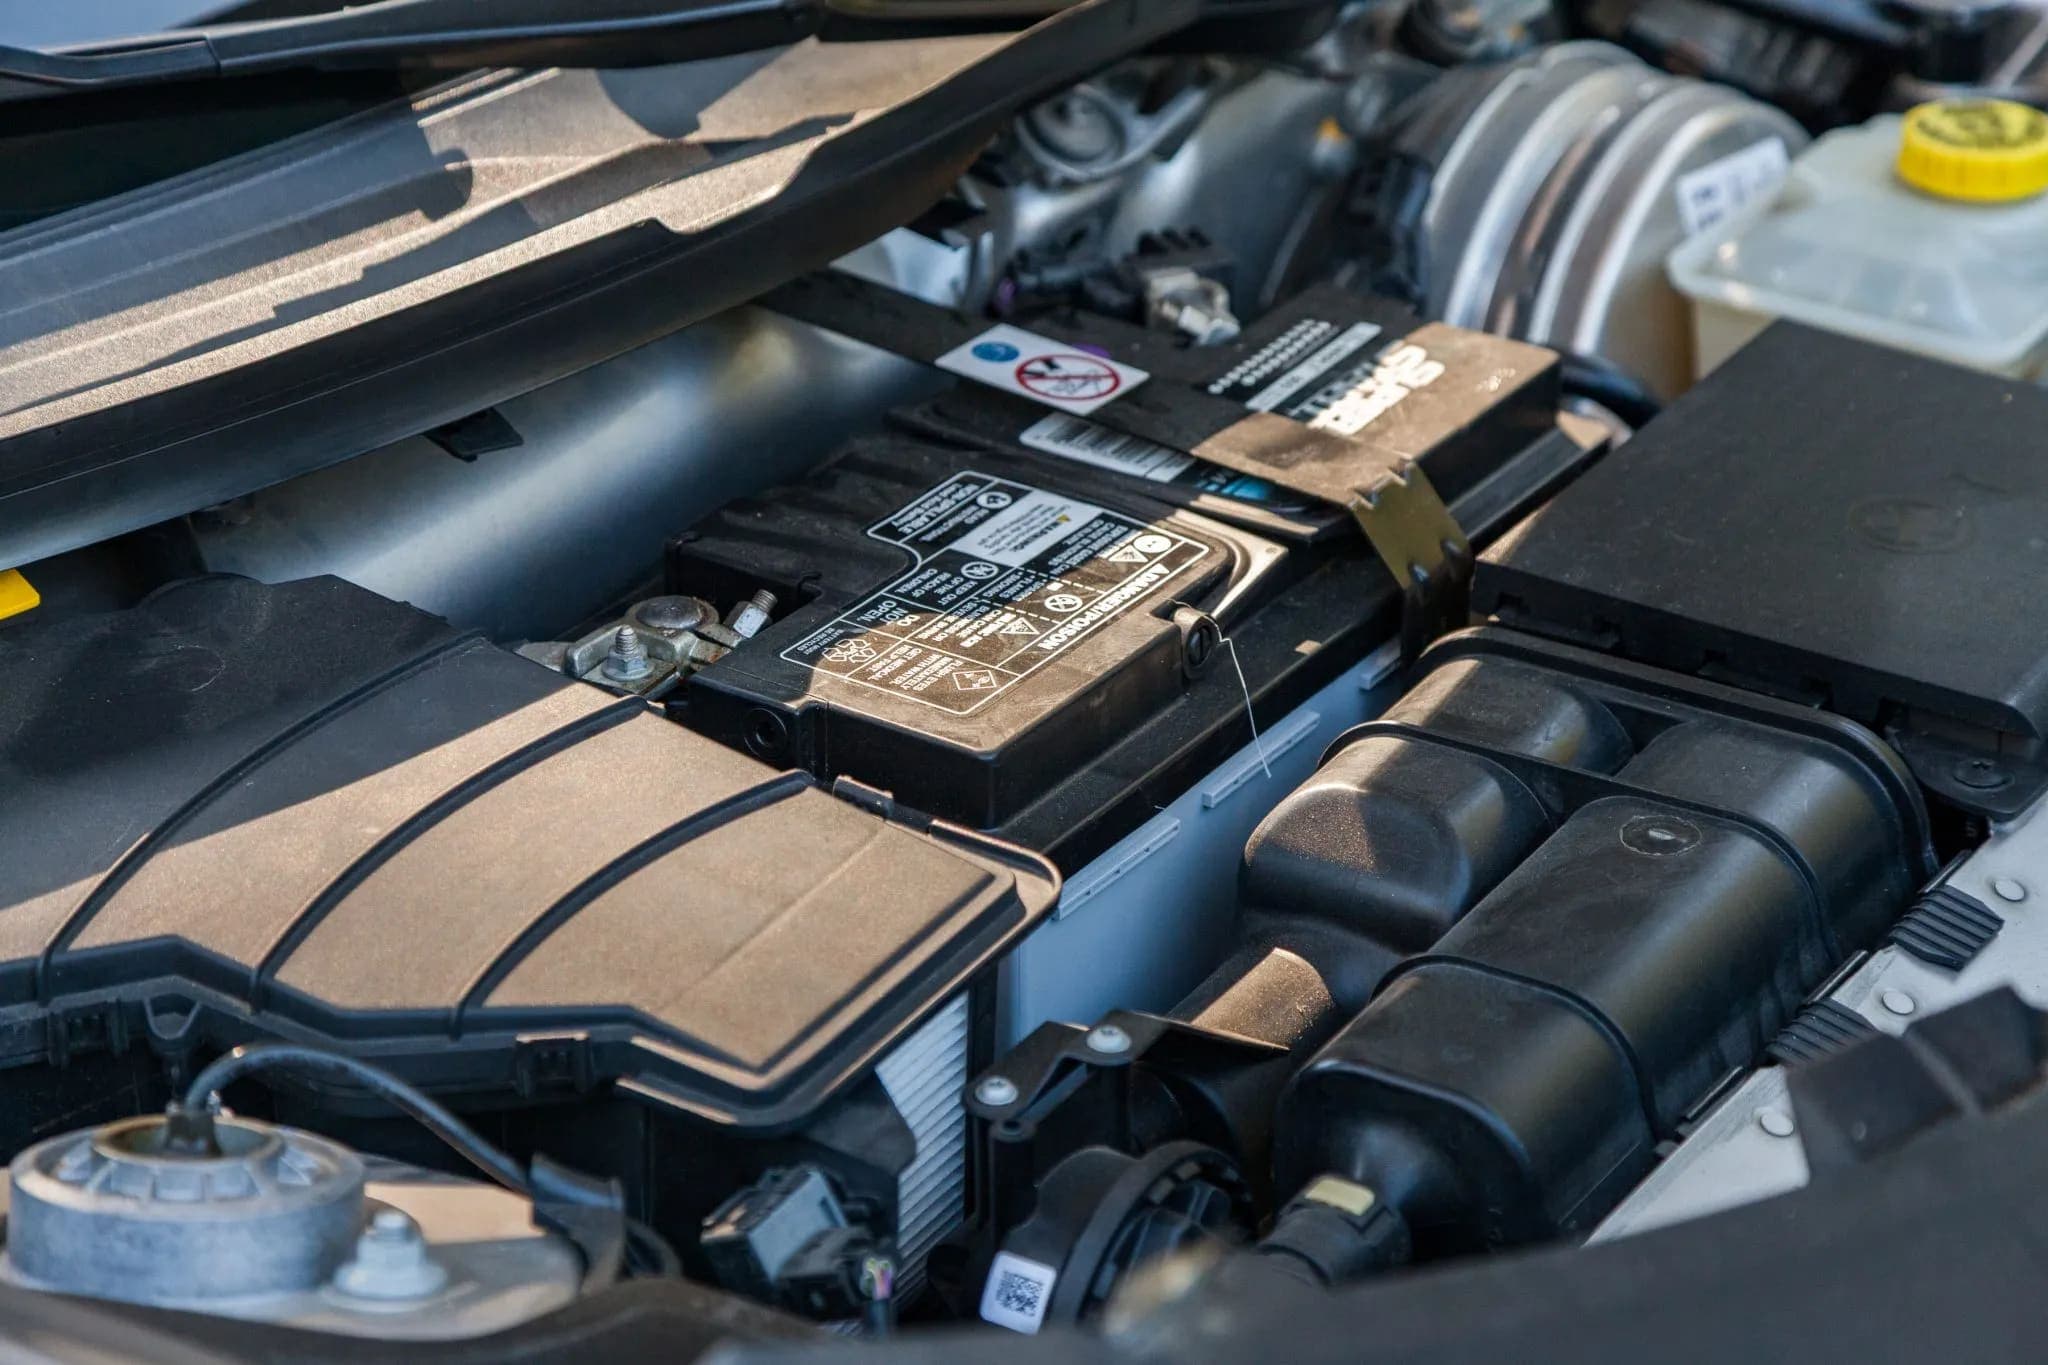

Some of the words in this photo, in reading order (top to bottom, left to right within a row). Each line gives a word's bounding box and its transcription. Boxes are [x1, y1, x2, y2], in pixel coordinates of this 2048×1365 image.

[1049, 563, 1072, 575] CAN
[893, 568, 937, 593] CHILDREN.
[920, 571, 951, 589] REACH
[948, 575, 964, 584] OF
[952, 580, 978, 594] KEEP
[981, 573, 1021, 597] SMOKING
[997, 577, 1033, 598] FLAMES
[907, 588, 925, 597] OF
[932, 582, 954, 594] THE
[935, 593, 957, 605] OUT
[855, 599, 897, 623] OPEN.
[876, 607, 908, 625] NOT
[942, 601, 978, 622] SEVERE
[980, 608, 1003, 621] CAN
[1036, 570, 1160, 649] DANGER/POISON
[894, 613, 920, 627] DO
[942, 605, 990, 633] BLINDNESS
[816, 629, 844, 645] BATTERY
[930, 631, 949, 641] OR
[886, 644, 912, 659] HELP
[900, 647, 923, 660] GET
[865, 657, 891, 673] FAST.
[916, 653, 942, 667] WITH
[932, 659, 963, 677] FLUSH
[887, 665, 923, 685] WATER.
[898, 656, 953, 690] IMMEDIATELY
[911, 676, 938, 691] EYES
